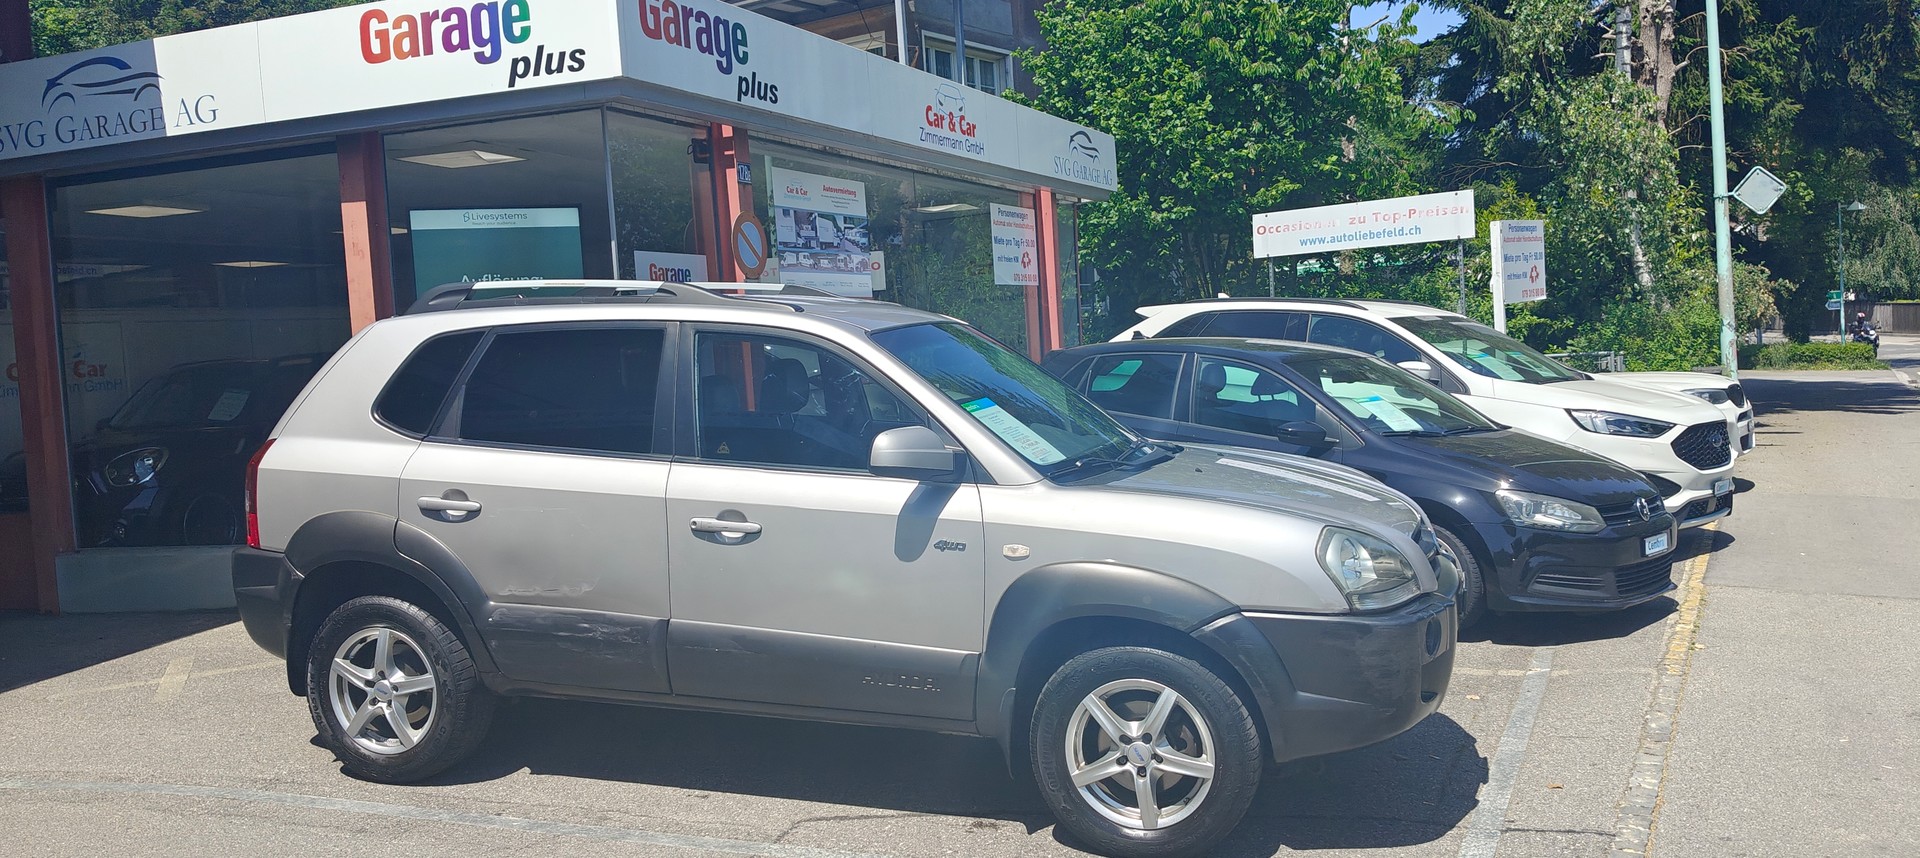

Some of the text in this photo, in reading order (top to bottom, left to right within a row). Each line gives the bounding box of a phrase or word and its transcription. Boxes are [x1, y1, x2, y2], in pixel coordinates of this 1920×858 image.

[359, 0, 532, 65] Garage
[638, 0, 749, 75] Garage
[508, 45, 586, 88] plus
[737, 71, 779, 104] plus
[55, 106, 167, 144] GARAGE
[174, 94, 219, 128] AG
[925, 104, 977, 138] Car & Car
[919, 126, 985, 156] Zimmermann GmbH
[1053, 155, 1113, 187] SVG GARAGE AG
[786, 185, 795, 194] Car
[799, 187, 808, 197] Car
[822, 184, 857, 198] Autovermietung
[471, 213, 528, 221] Livesystems
[997, 207, 1029, 222] Personenwagen
[1348, 215, 1367, 225] zu
[1299, 225, 1422, 247] www.autoliebefeld.ch
[1508, 223, 1538, 235] Personenwagen
[993, 235, 1005, 246] Miete
[1012, 237, 1020, 249] Tag
[1503, 253, 1515, 263] Miete
[649, 263, 692, 282] Garage
